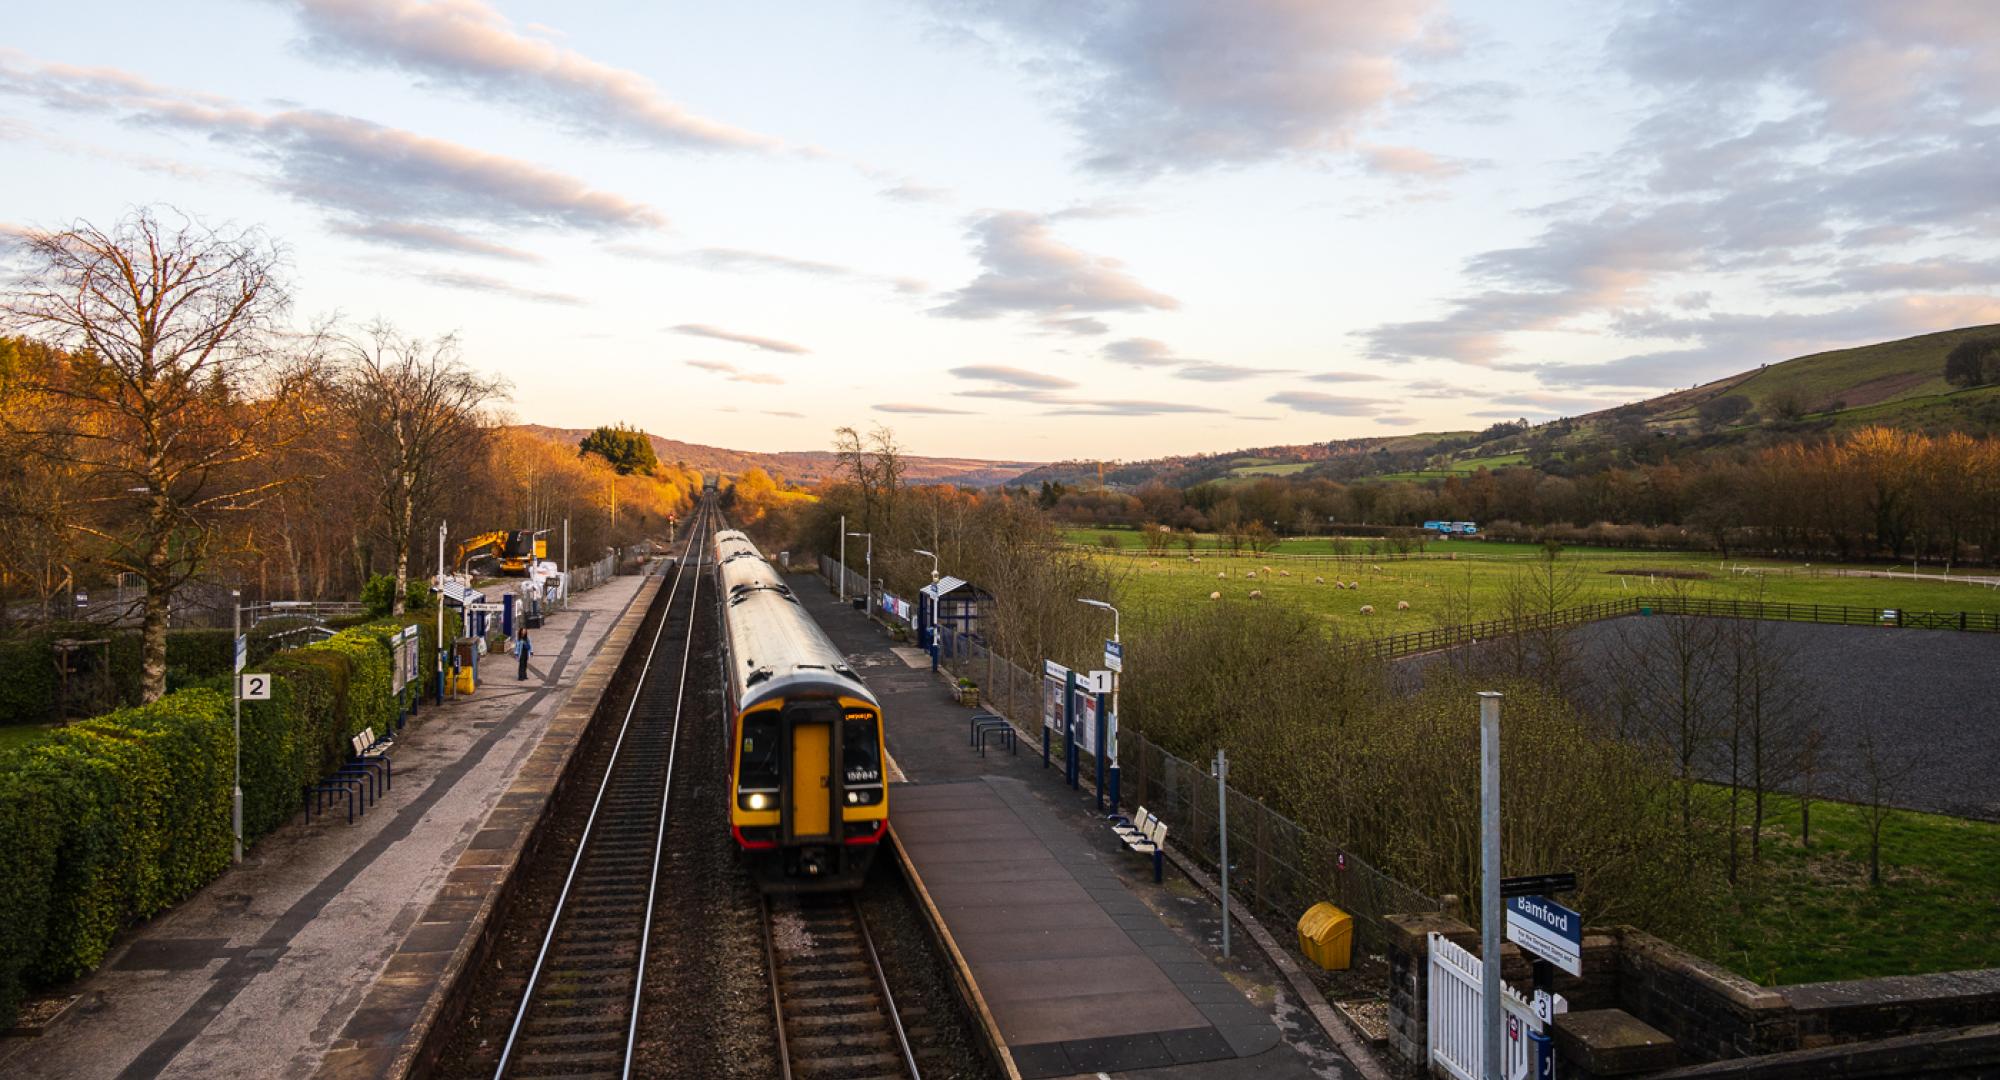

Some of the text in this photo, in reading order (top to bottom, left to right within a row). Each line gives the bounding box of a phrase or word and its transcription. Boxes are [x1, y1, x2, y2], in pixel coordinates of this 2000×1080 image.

[249, 677, 264, 696] 2
[1096, 674, 1103, 689] 1
[1518, 896, 1568, 932] Bamford
[1539, 999, 1547, 1019] 3
